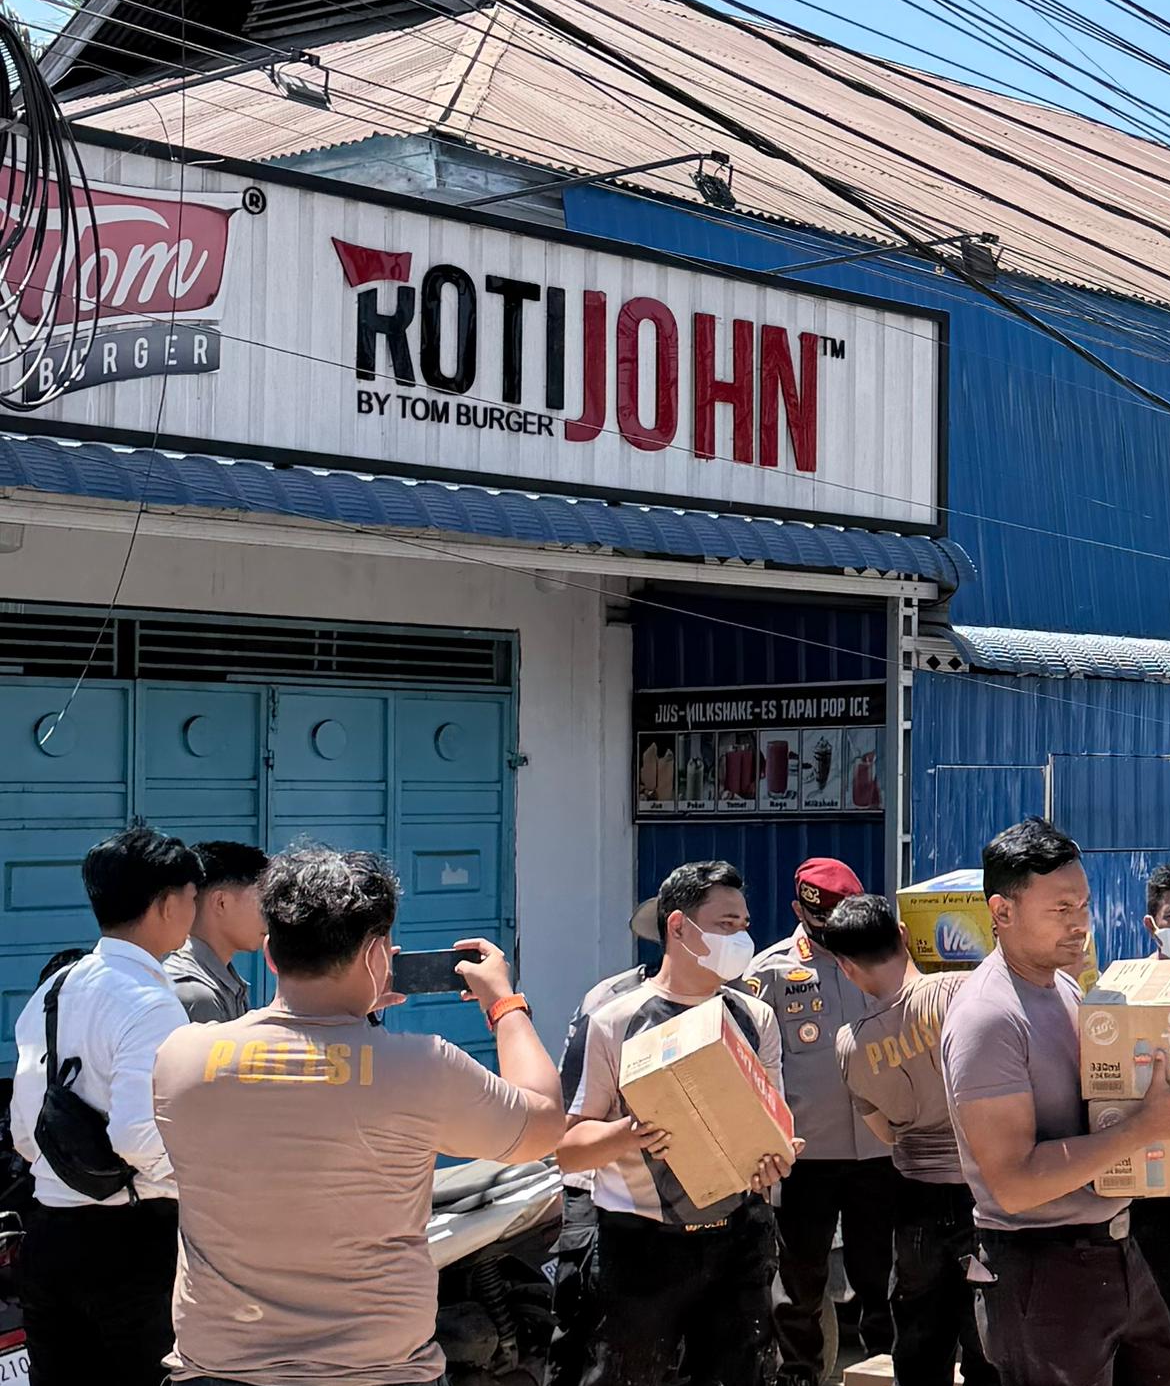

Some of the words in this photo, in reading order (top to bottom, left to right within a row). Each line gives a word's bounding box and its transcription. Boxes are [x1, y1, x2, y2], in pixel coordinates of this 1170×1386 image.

[565, 290, 819, 473] JOHN
[357, 390, 390, 416] BY
[398, 395, 450, 426] TOM
[456, 403, 554, 438] BURGER
[781, 698, 818, 719] TAPAI
[820, 697, 846, 718] POP
[849, 696, 870, 717] ICE
